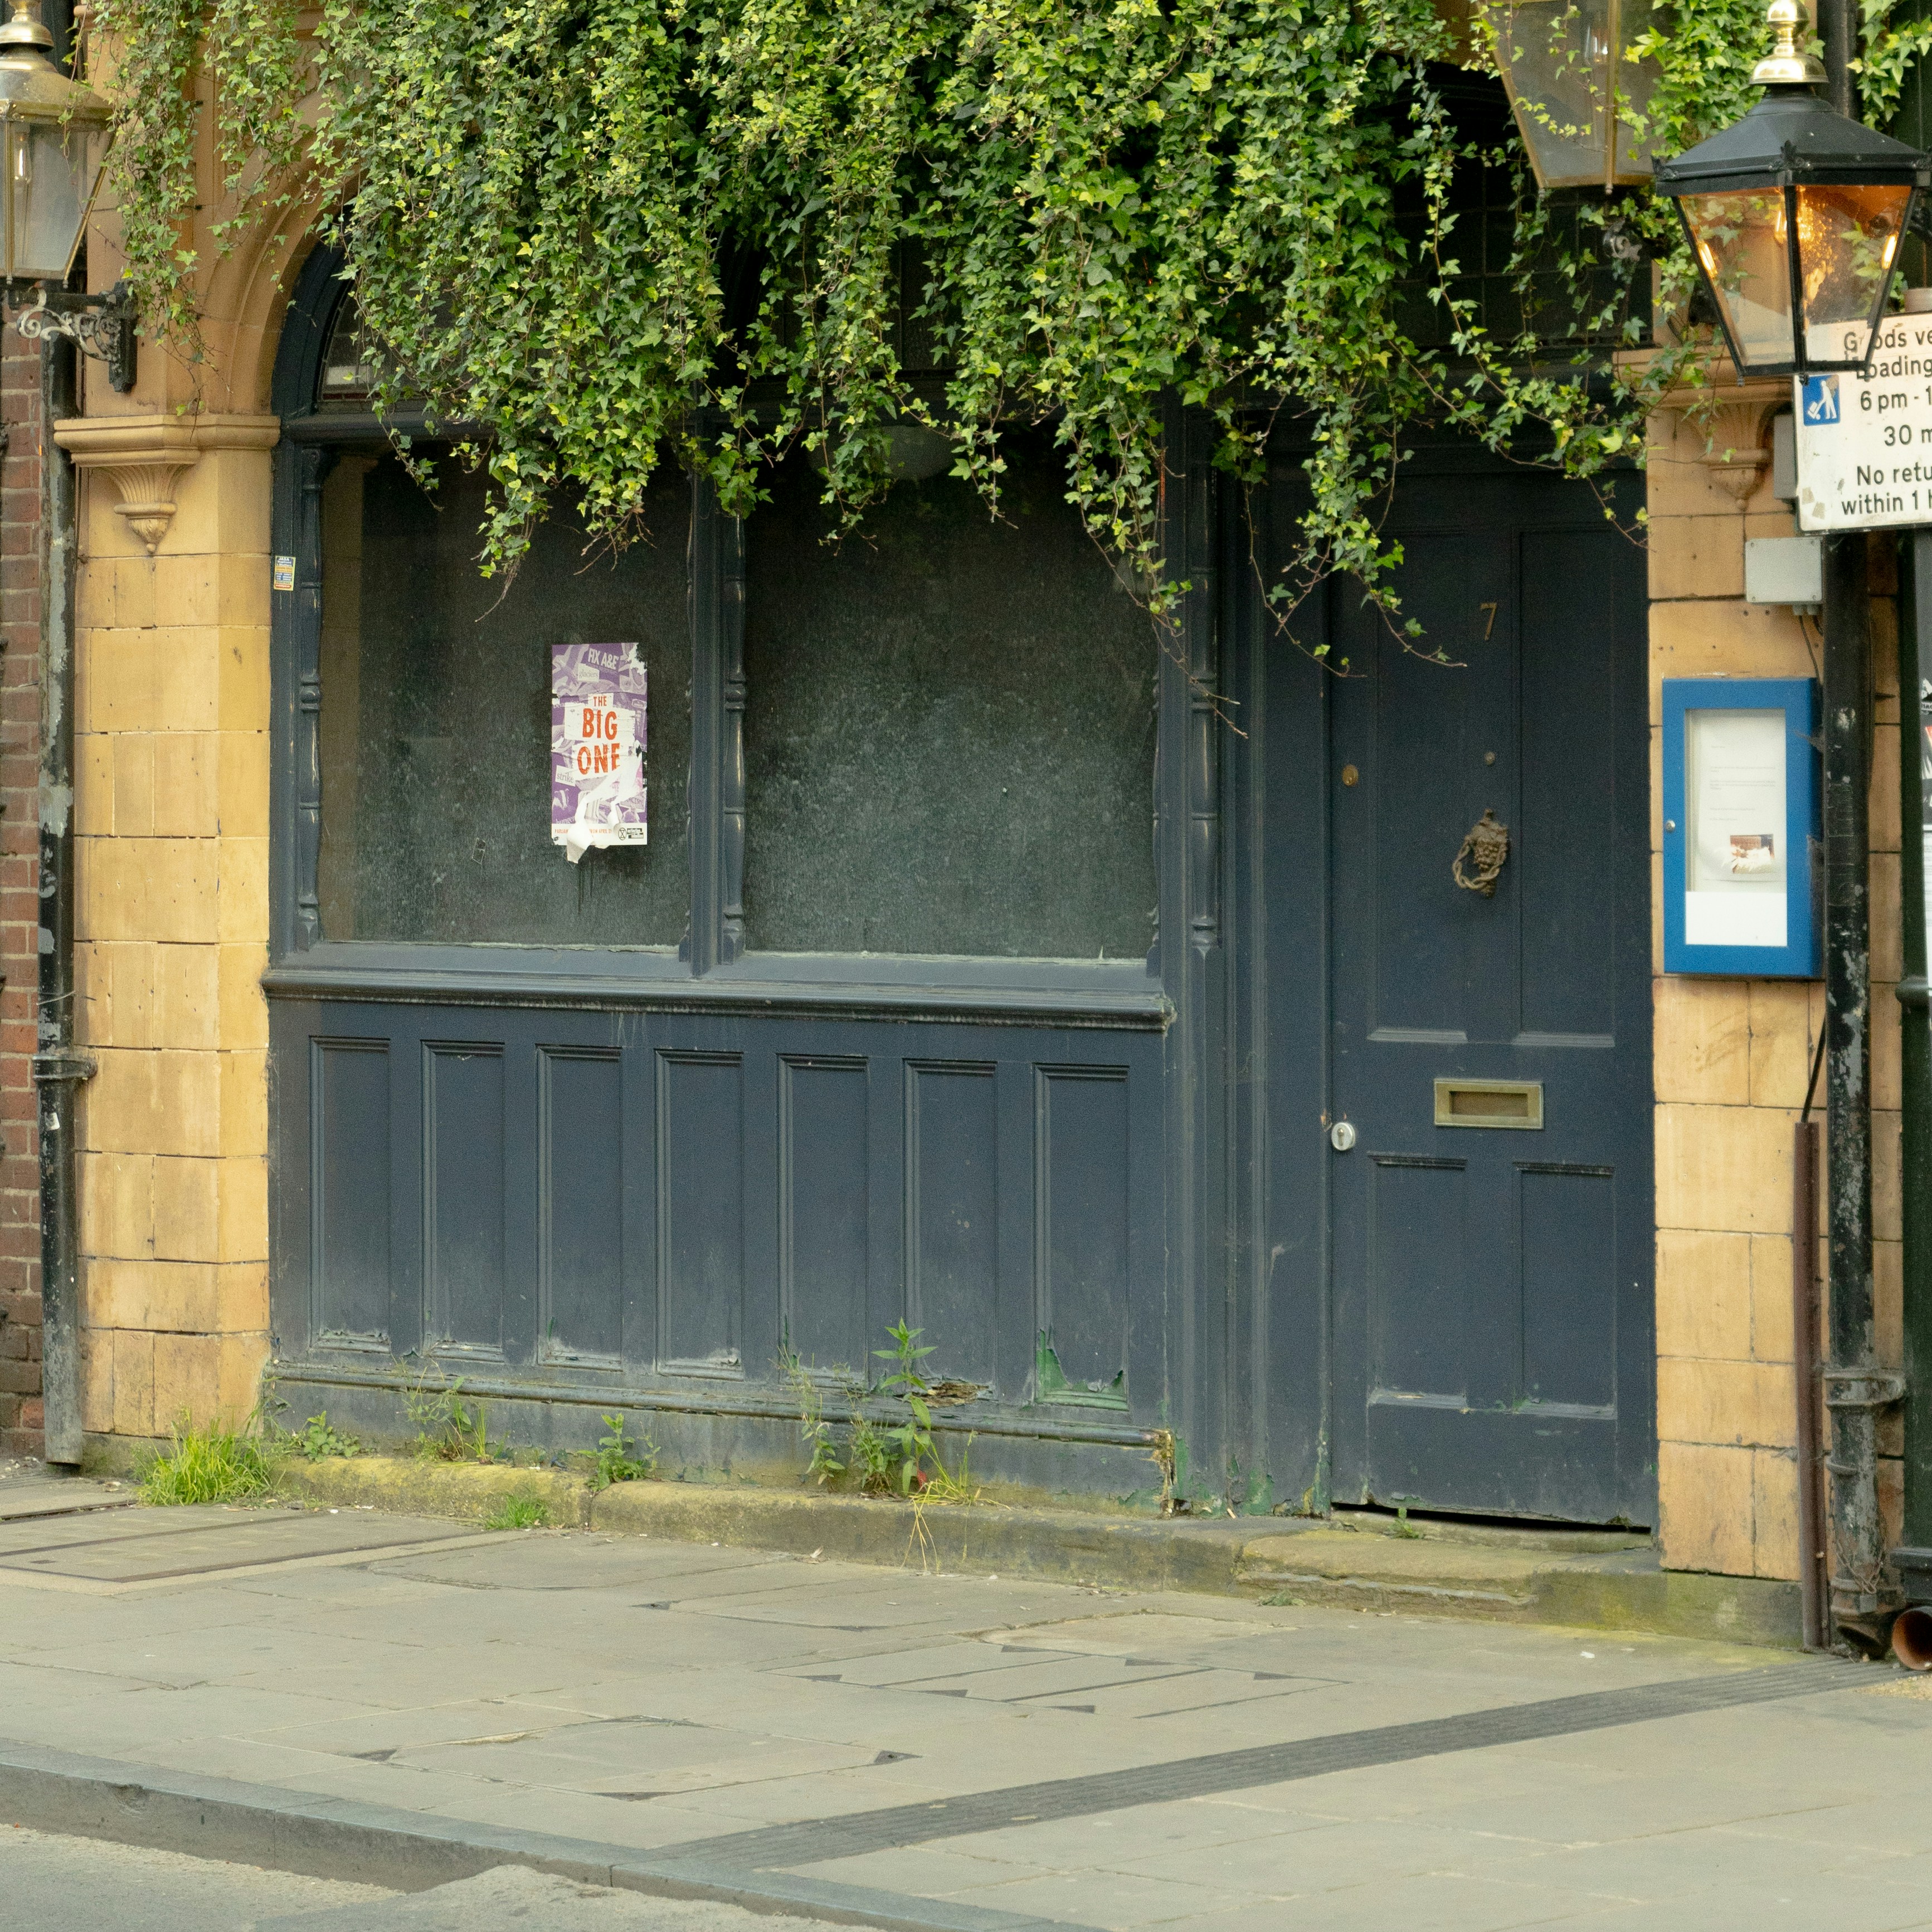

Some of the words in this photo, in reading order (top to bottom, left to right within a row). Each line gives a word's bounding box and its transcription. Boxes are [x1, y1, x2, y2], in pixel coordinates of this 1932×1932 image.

[1844, 328, 1907, 353] Gods
[1884, 424, 1912, 447] 30
[1857, 465, 1885, 486] No
[1841, 492, 1904, 515] within
[1912, 490, 1919, 510] 1
[1480, 602, 1497, 641] 7
[588, 648, 600, 665] FIX
[601, 653, 619, 670] A&E
[593, 696, 607, 707] THE
[582, 708, 618, 741] BIG
[577, 743, 620, 775] ONE
[556, 772, 574, 783] strike
